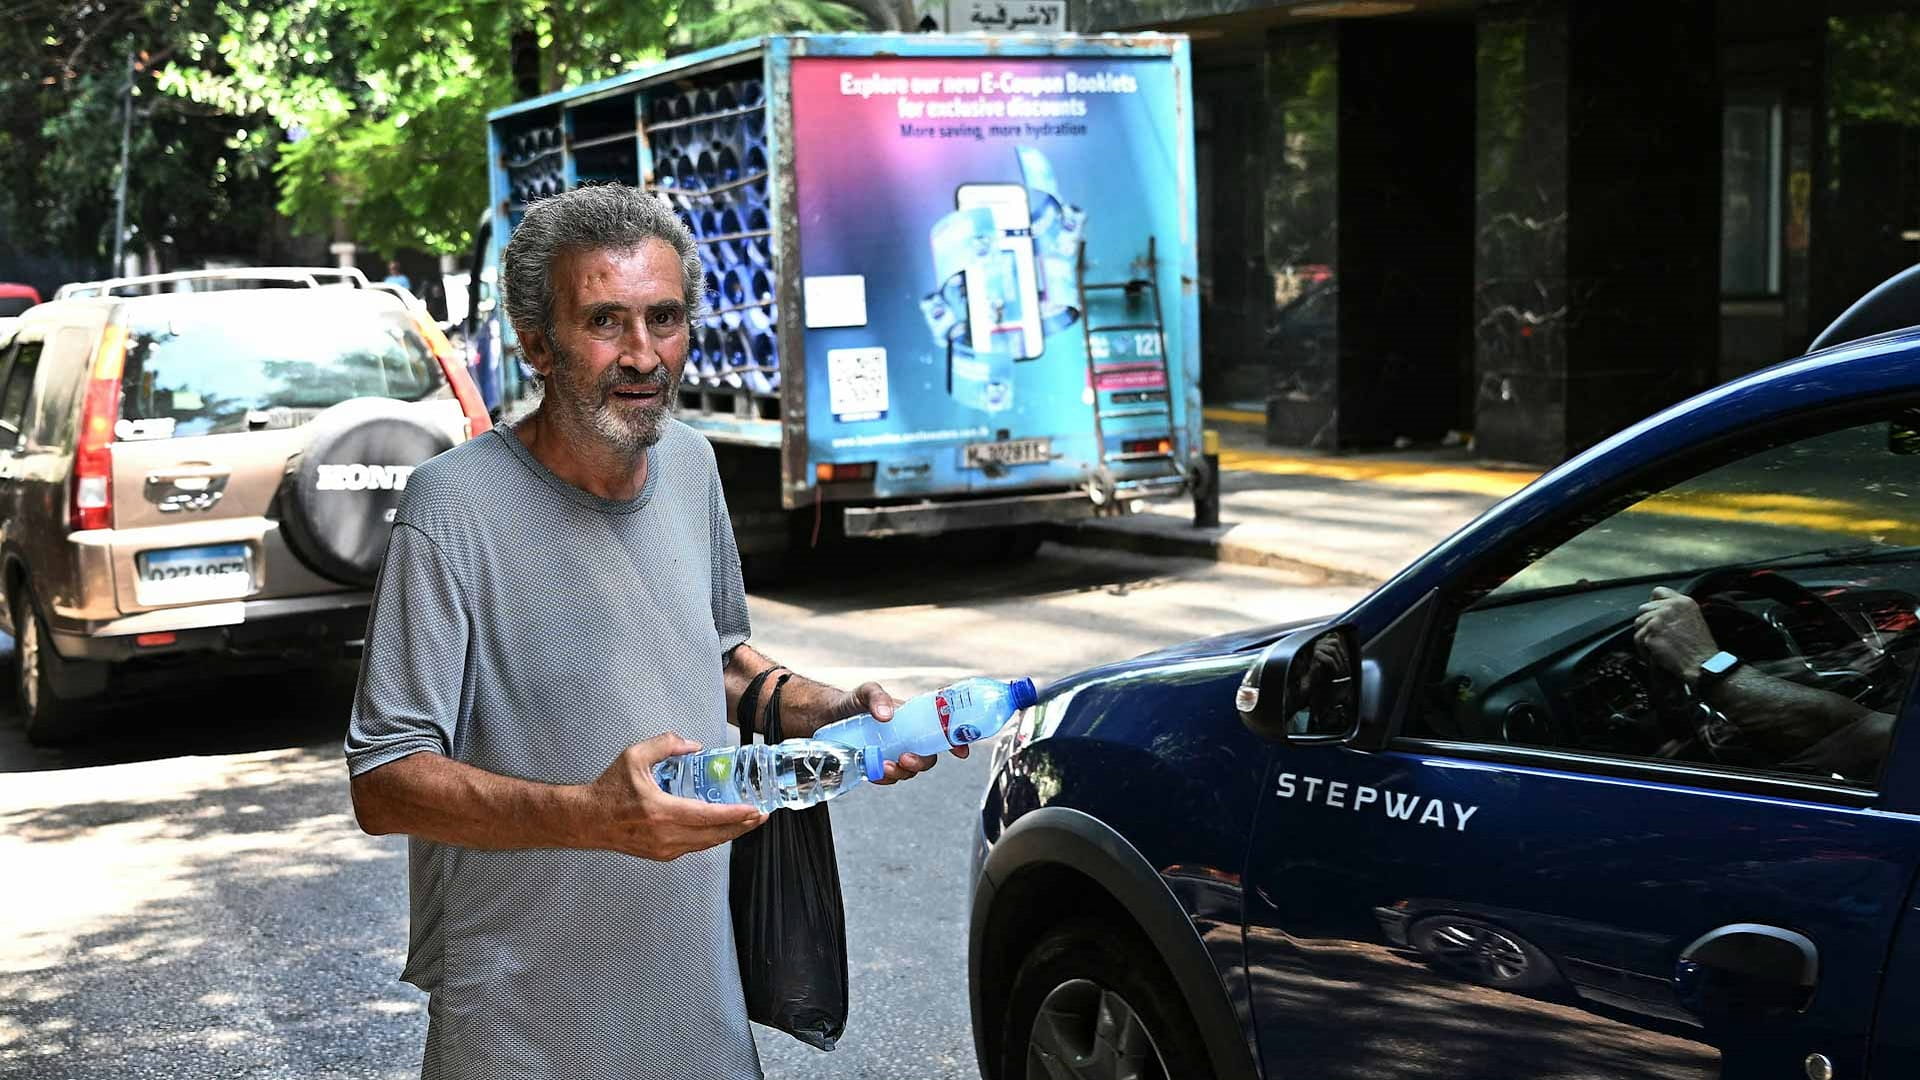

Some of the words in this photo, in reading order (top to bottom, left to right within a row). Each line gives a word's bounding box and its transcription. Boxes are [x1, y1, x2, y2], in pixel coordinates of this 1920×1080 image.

[840, 72, 908, 98] Explore
[910, 77, 941, 94] our
[943, 77, 979, 94] new
[981, 72, 1064, 97] E-Coupon
[1066, 71, 1138, 93] Booklets
[898, 97, 925, 118] for
[926, 97, 1004, 118] exclusive
[1006, 97, 1087, 117] discounts
[901, 124, 935, 137] More
[989, 125, 1021, 136] more
[1025, 122, 1087, 139] hydration
[1276, 772, 1479, 831] STEPWAY
